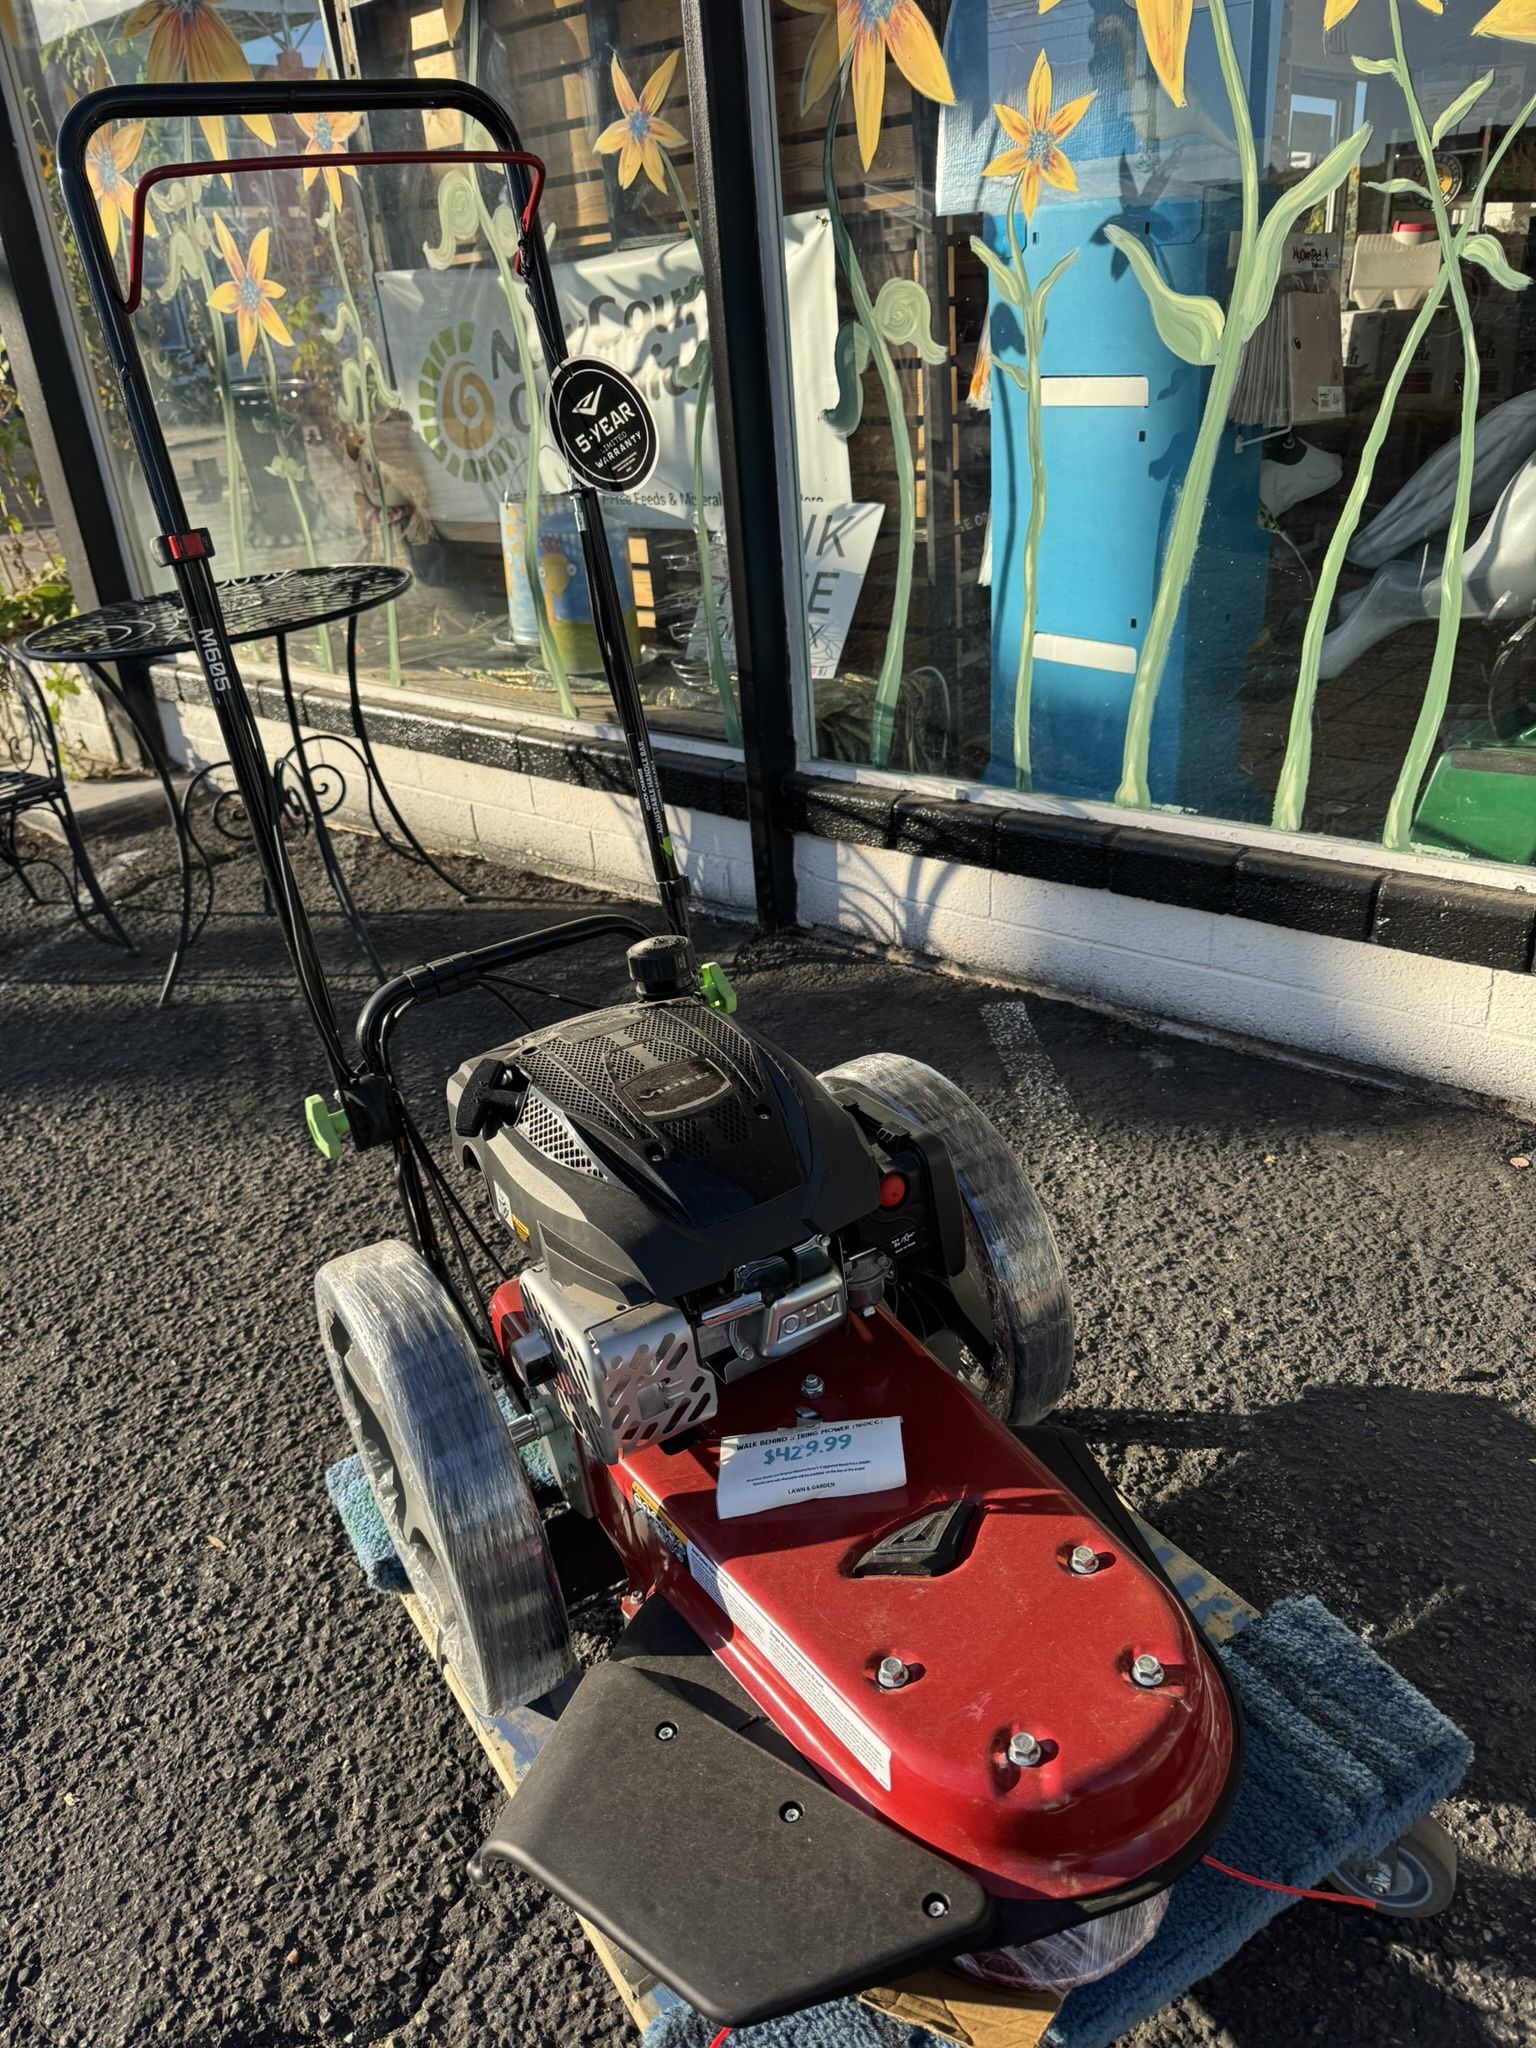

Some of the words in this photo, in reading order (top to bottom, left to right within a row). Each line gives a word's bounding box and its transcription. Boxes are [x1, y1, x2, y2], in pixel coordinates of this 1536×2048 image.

[595, 431, 641, 468] WARRANTY
[601, 431, 627, 454] LIMITED
[634, 492, 667, 506] Feeds
[668, 492, 677, 506] &
[198, 628, 231, 691] M605
[638, 740, 646, 757] BAR
[641, 757, 654, 788] HANDLE
[649, 789, 664, 833] ADJUSTABLE
[781, 1294, 836, 1334] OHV
[736, 1441, 758, 1451] WALK
[759, 1436, 788, 1446] BEHIND
[789, 1431, 818, 1441] STRING
[820, 1424, 850, 1434] MOWER
[764, 1433, 853, 1465] $429.99
[788, 1485, 806, 1494] LAWN
[811, 1482, 835, 1490] GARDEN
